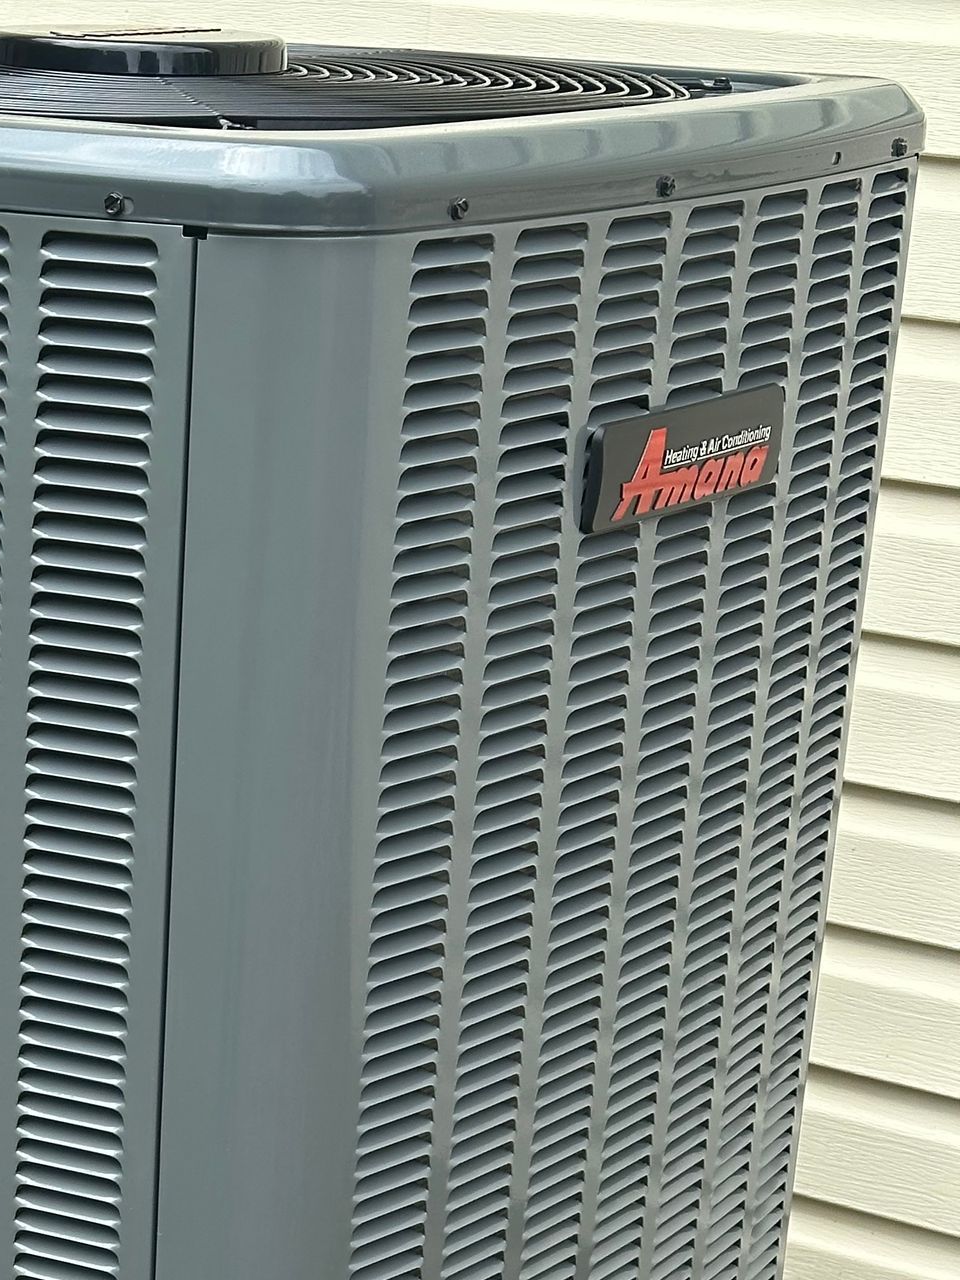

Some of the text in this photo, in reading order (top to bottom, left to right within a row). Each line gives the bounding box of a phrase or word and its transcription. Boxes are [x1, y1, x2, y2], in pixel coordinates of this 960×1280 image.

[611, 427, 769, 521] Amana
[663, 425, 771, 465] Heating & Air Conditioning
